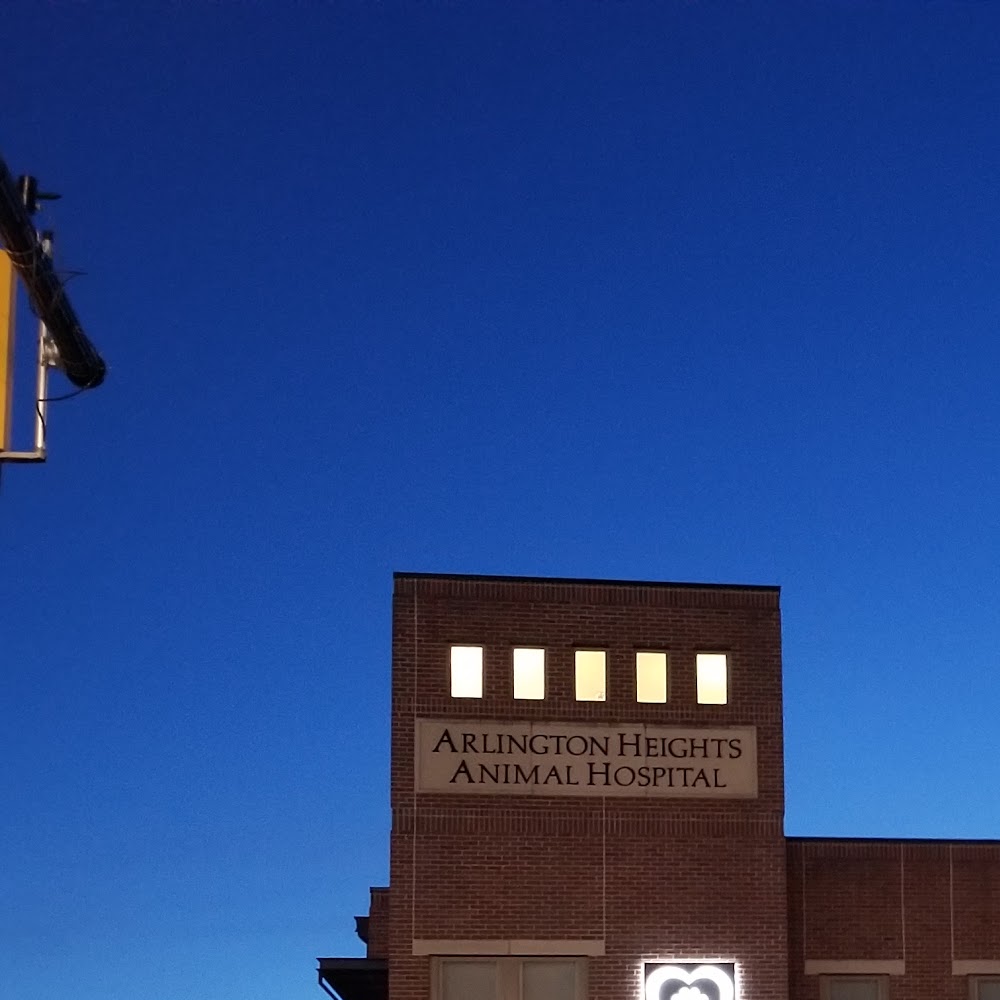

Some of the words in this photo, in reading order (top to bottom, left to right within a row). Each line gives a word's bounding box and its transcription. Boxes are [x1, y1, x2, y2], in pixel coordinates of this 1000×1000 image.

[432, 728, 609, 757] ARLINGTON
[617, 733, 742, 759] HEIGHTS
[449, 759, 580, 786] ANIMAL
[586, 761, 728, 789] HOSPITAL
